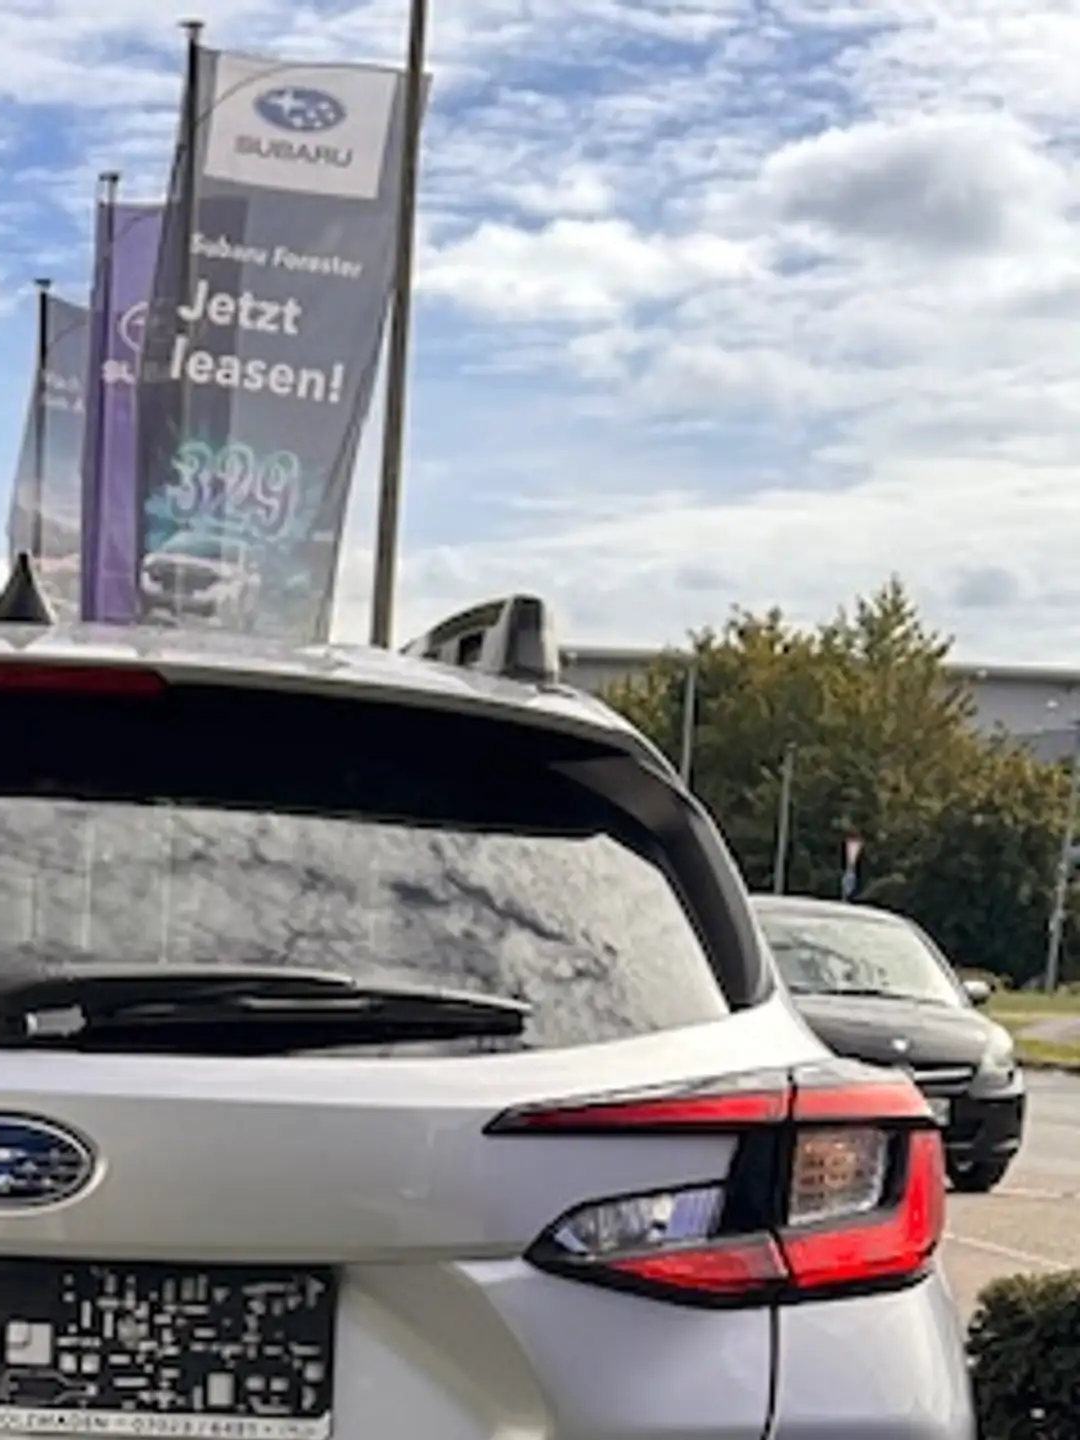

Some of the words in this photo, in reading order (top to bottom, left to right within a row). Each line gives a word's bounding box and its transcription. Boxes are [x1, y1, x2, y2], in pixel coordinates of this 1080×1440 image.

[234, 134, 354, 168] SUBARU
[191, 232, 268, 266] Subaru
[273, 246, 363, 279] Forester
[177, 279, 302, 335] Jetzt
[170, 335, 344, 403] leasen!
